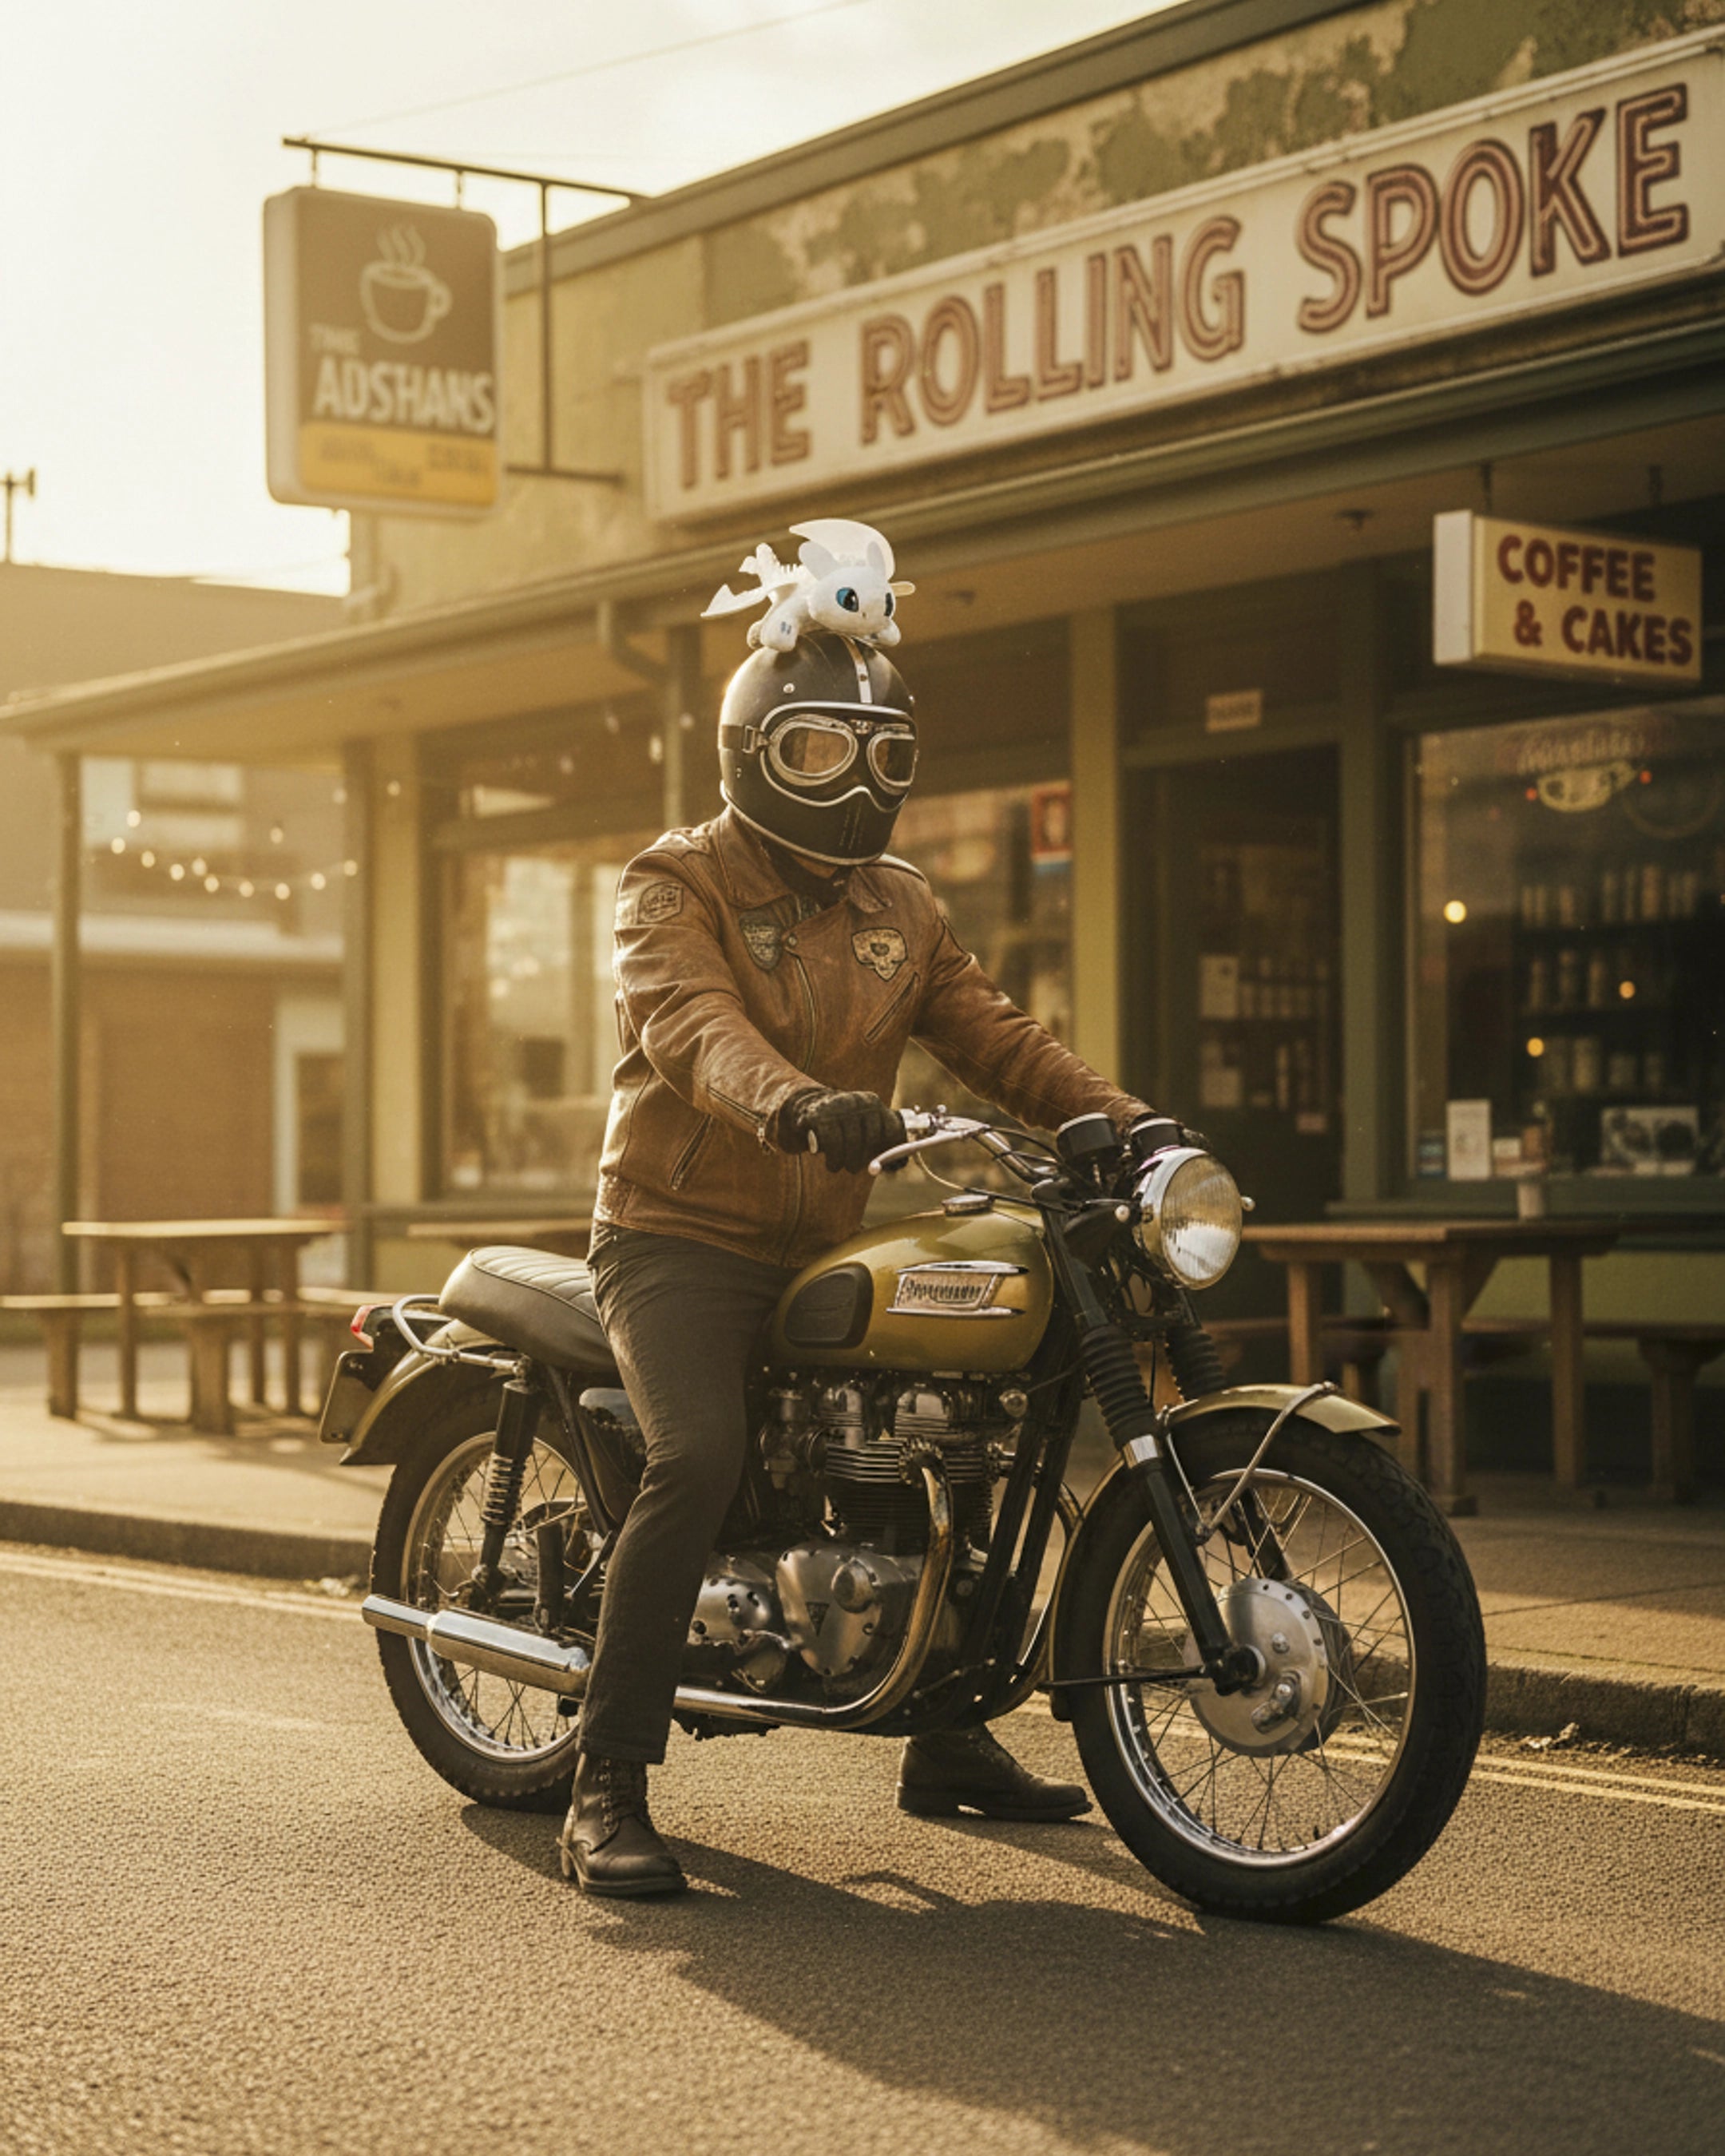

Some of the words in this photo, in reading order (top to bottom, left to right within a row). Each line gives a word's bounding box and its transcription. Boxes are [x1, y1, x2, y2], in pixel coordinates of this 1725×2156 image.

[668, 339, 812, 490] THE
[861, 215, 1247, 446] ROLLING
[1295, 82, 1690, 335] SPOKE
[1497, 534, 1656, 603] COFFEE
[1514, 600, 1542, 647] &
[1561, 605, 1693, 666] CAKES
